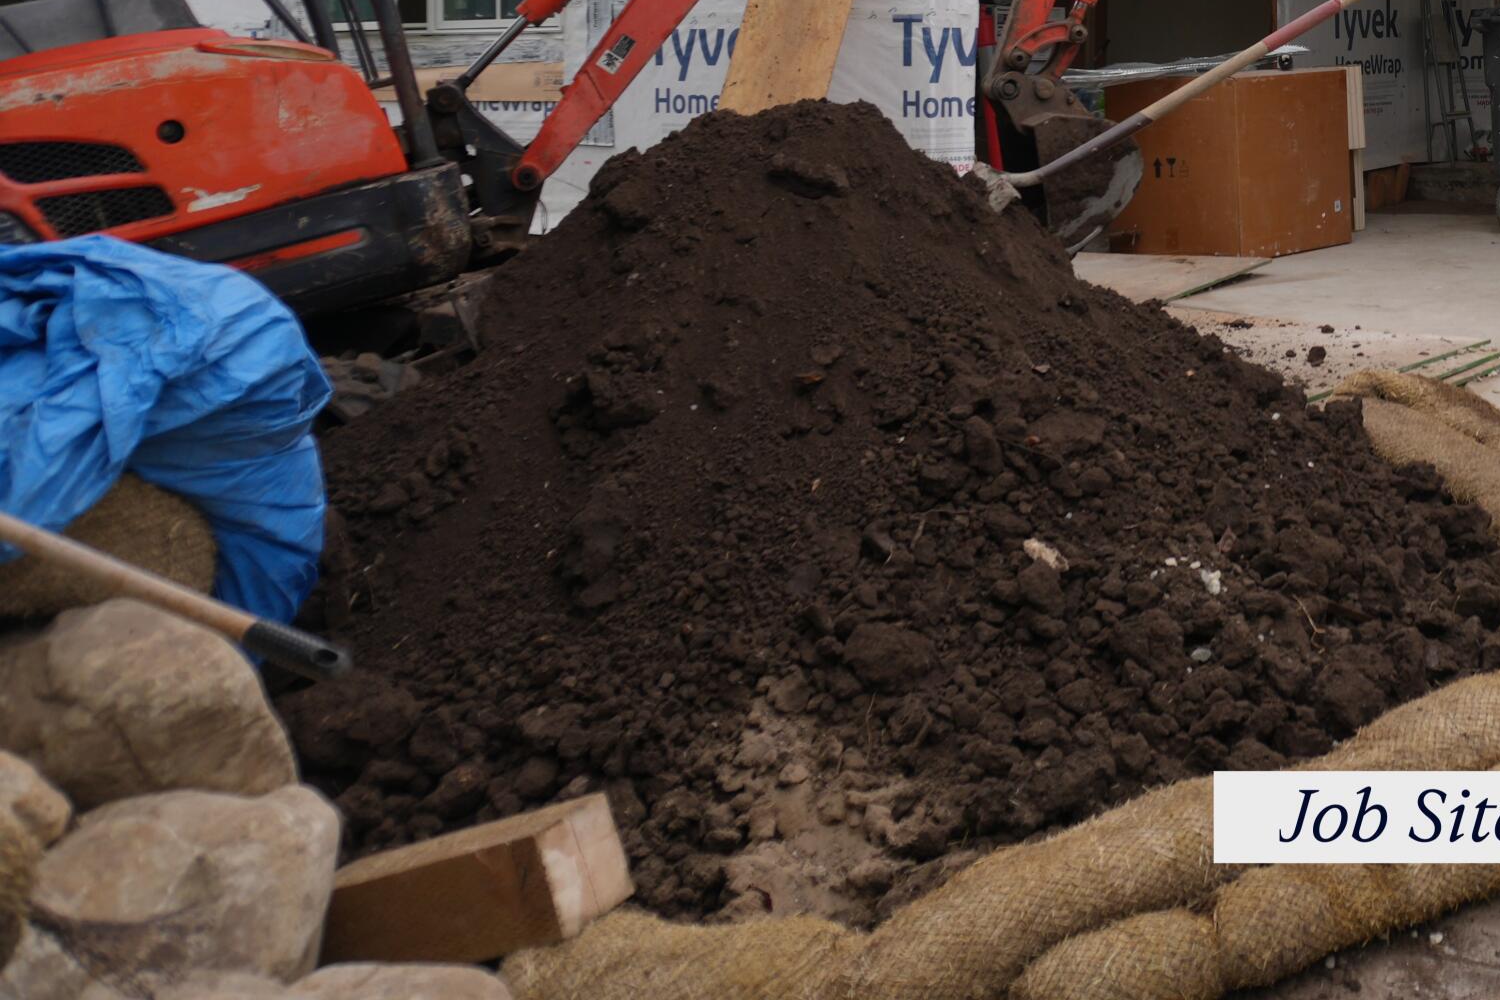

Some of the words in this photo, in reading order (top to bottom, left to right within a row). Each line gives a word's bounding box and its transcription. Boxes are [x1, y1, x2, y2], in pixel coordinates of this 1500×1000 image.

[892, 14, 979, 84] Tyv
[655, 87, 720, 114] Home
[902, 89, 976, 119] Home
